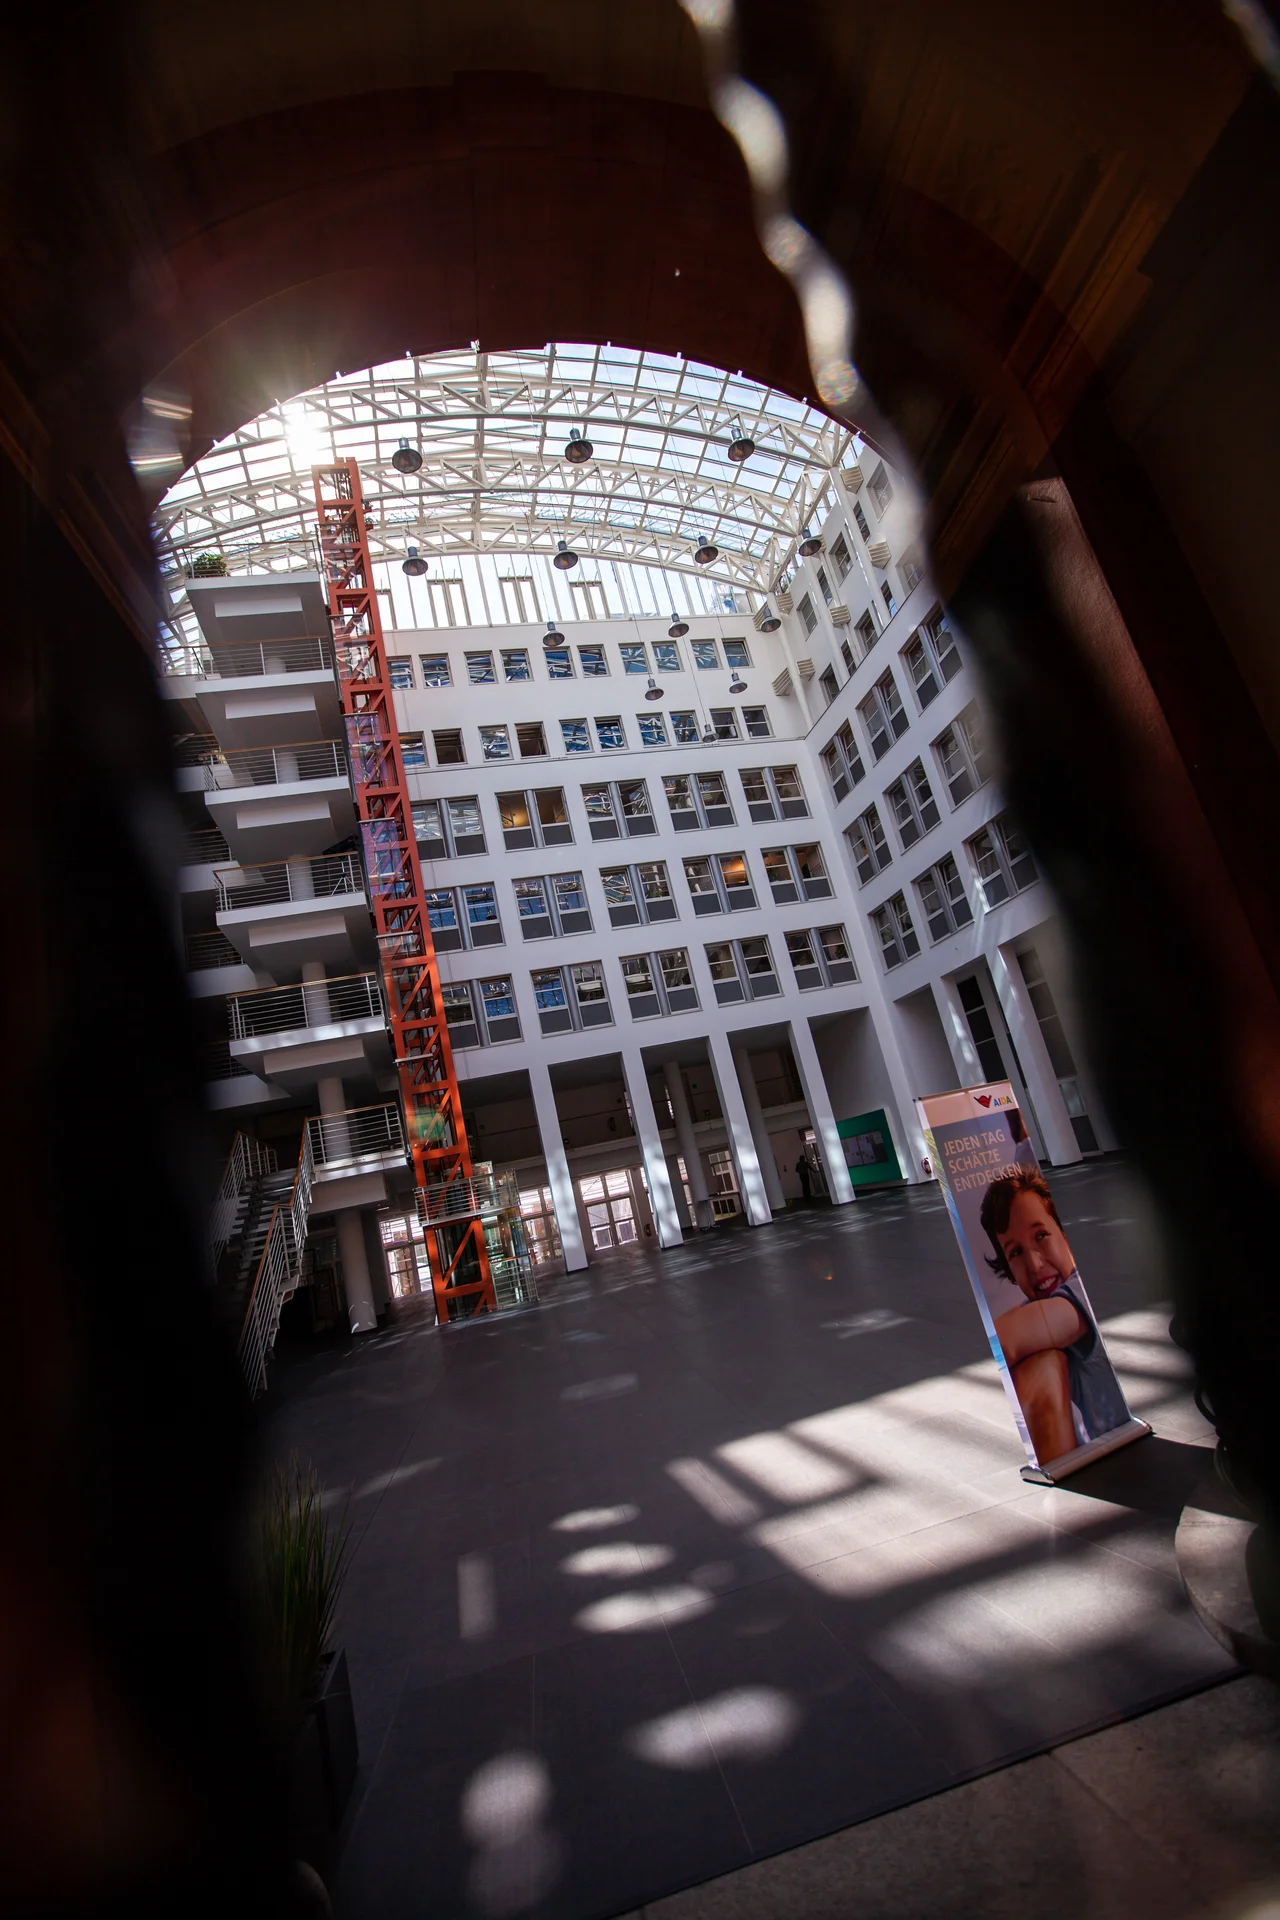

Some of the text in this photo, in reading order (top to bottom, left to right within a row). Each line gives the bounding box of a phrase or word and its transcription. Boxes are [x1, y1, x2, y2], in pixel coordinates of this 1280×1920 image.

[993, 1096, 1012, 1107] AIDA
[944, 1129, 1005, 1156] JEDEN TAG
[948, 1149, 1000, 1174] SCHÄTZE
[954, 1162, 1023, 1192] ENTDECKEN
